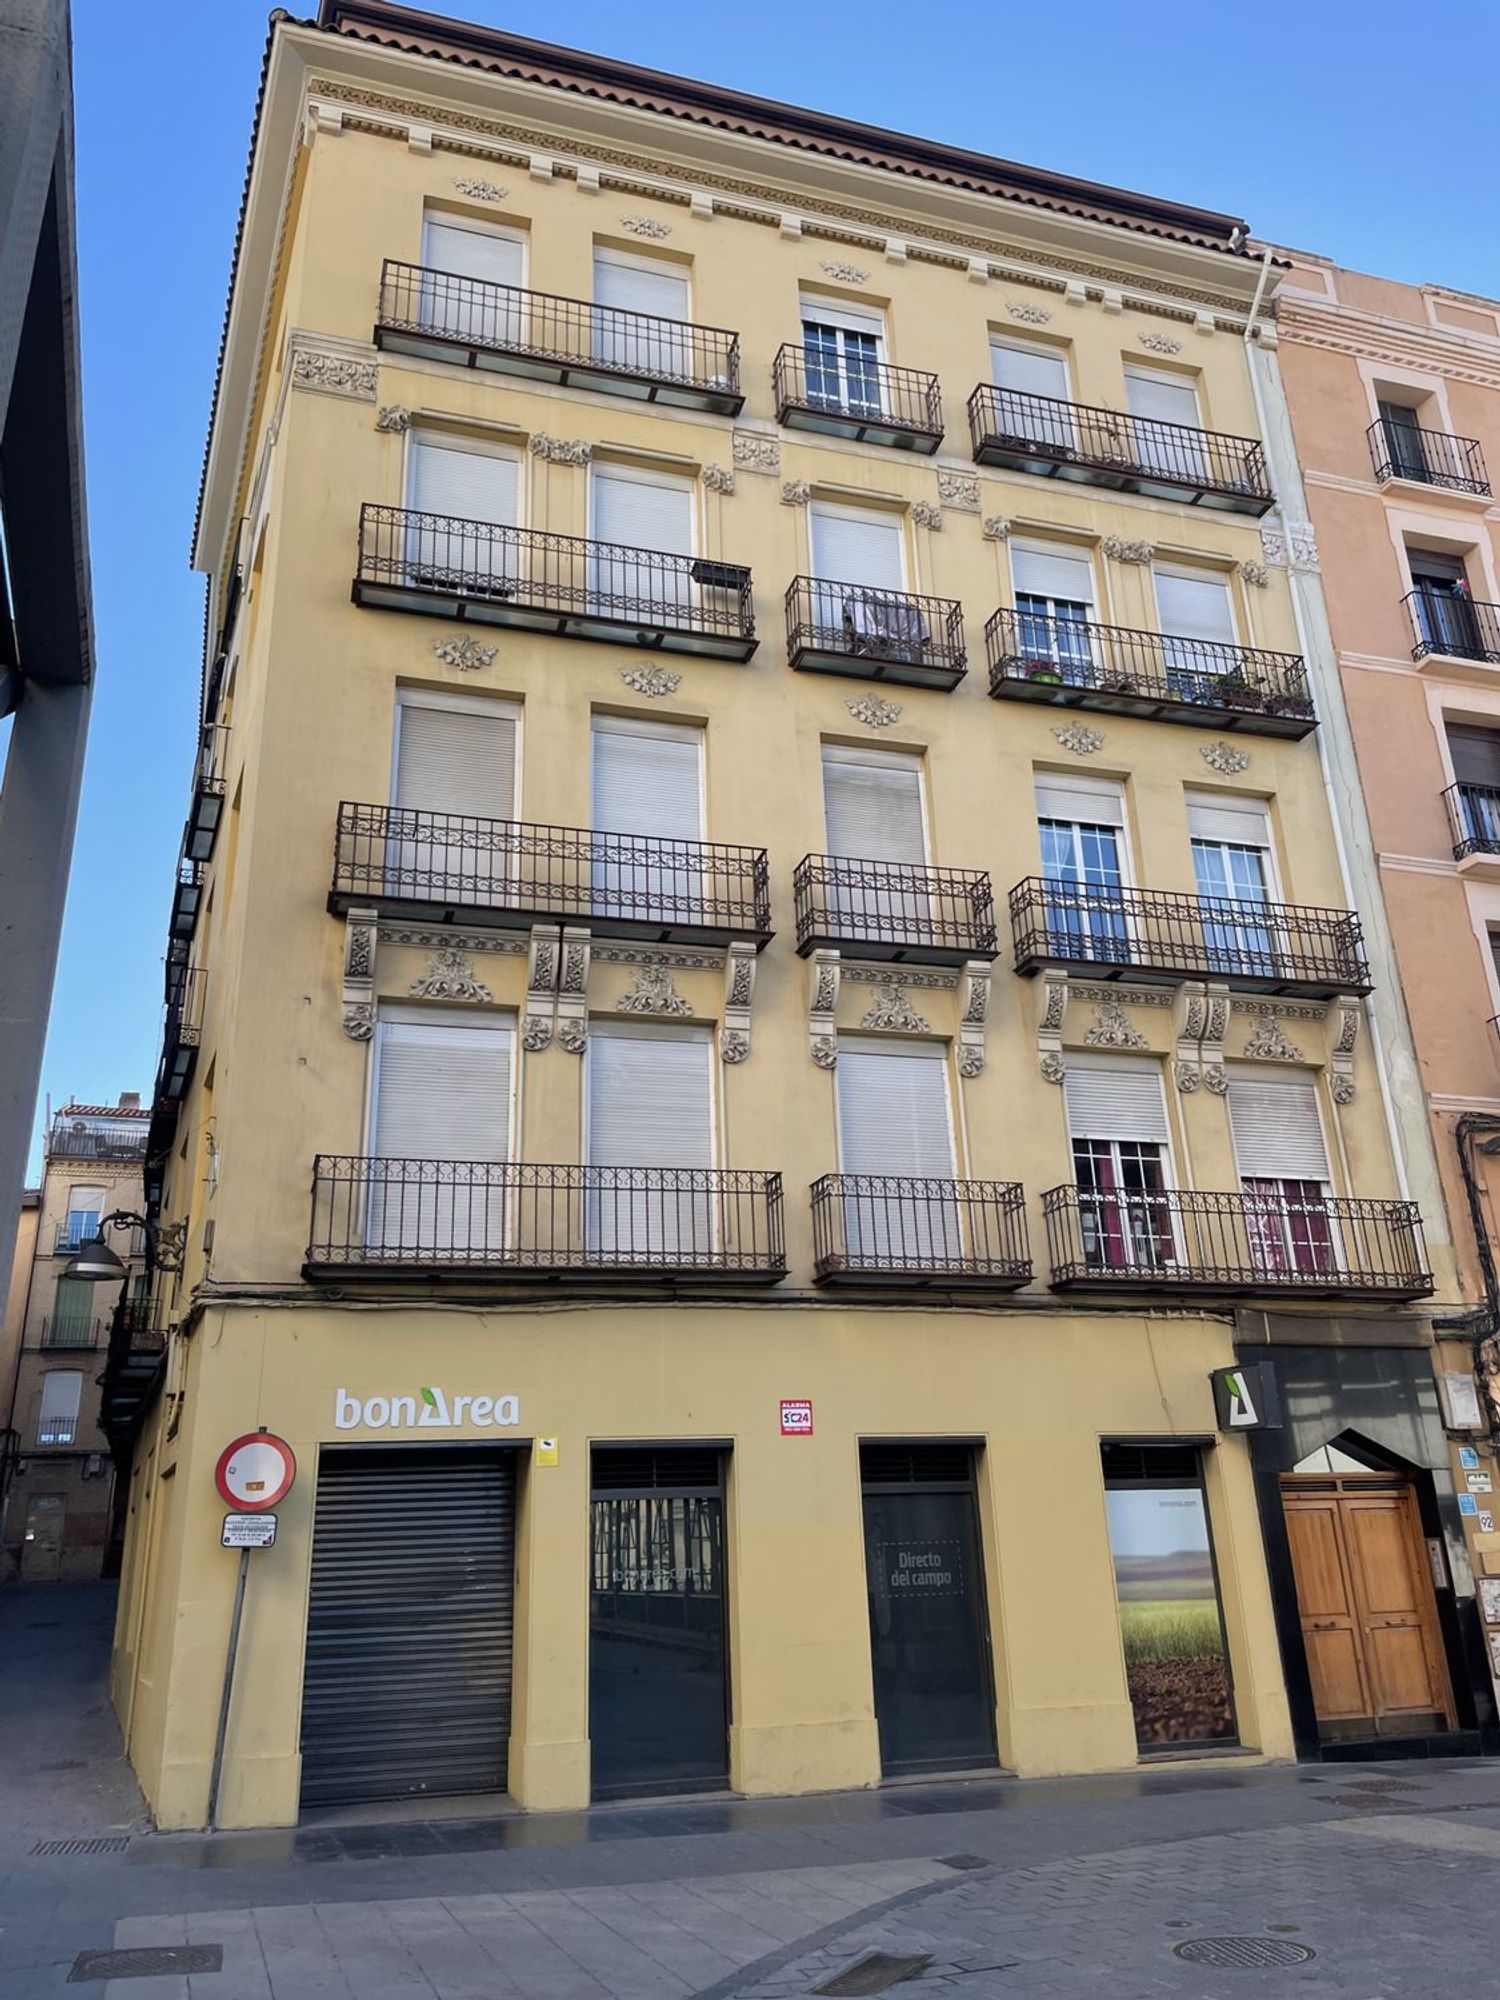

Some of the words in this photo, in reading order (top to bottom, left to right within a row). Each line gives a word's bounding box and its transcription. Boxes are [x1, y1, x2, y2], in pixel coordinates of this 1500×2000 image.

[1481, 1516, 1493, 1528] 92
[898, 1551, 942, 1568] Directo
[891, 1569, 911, 1587] del
[911, 1571, 952, 1588] campo
